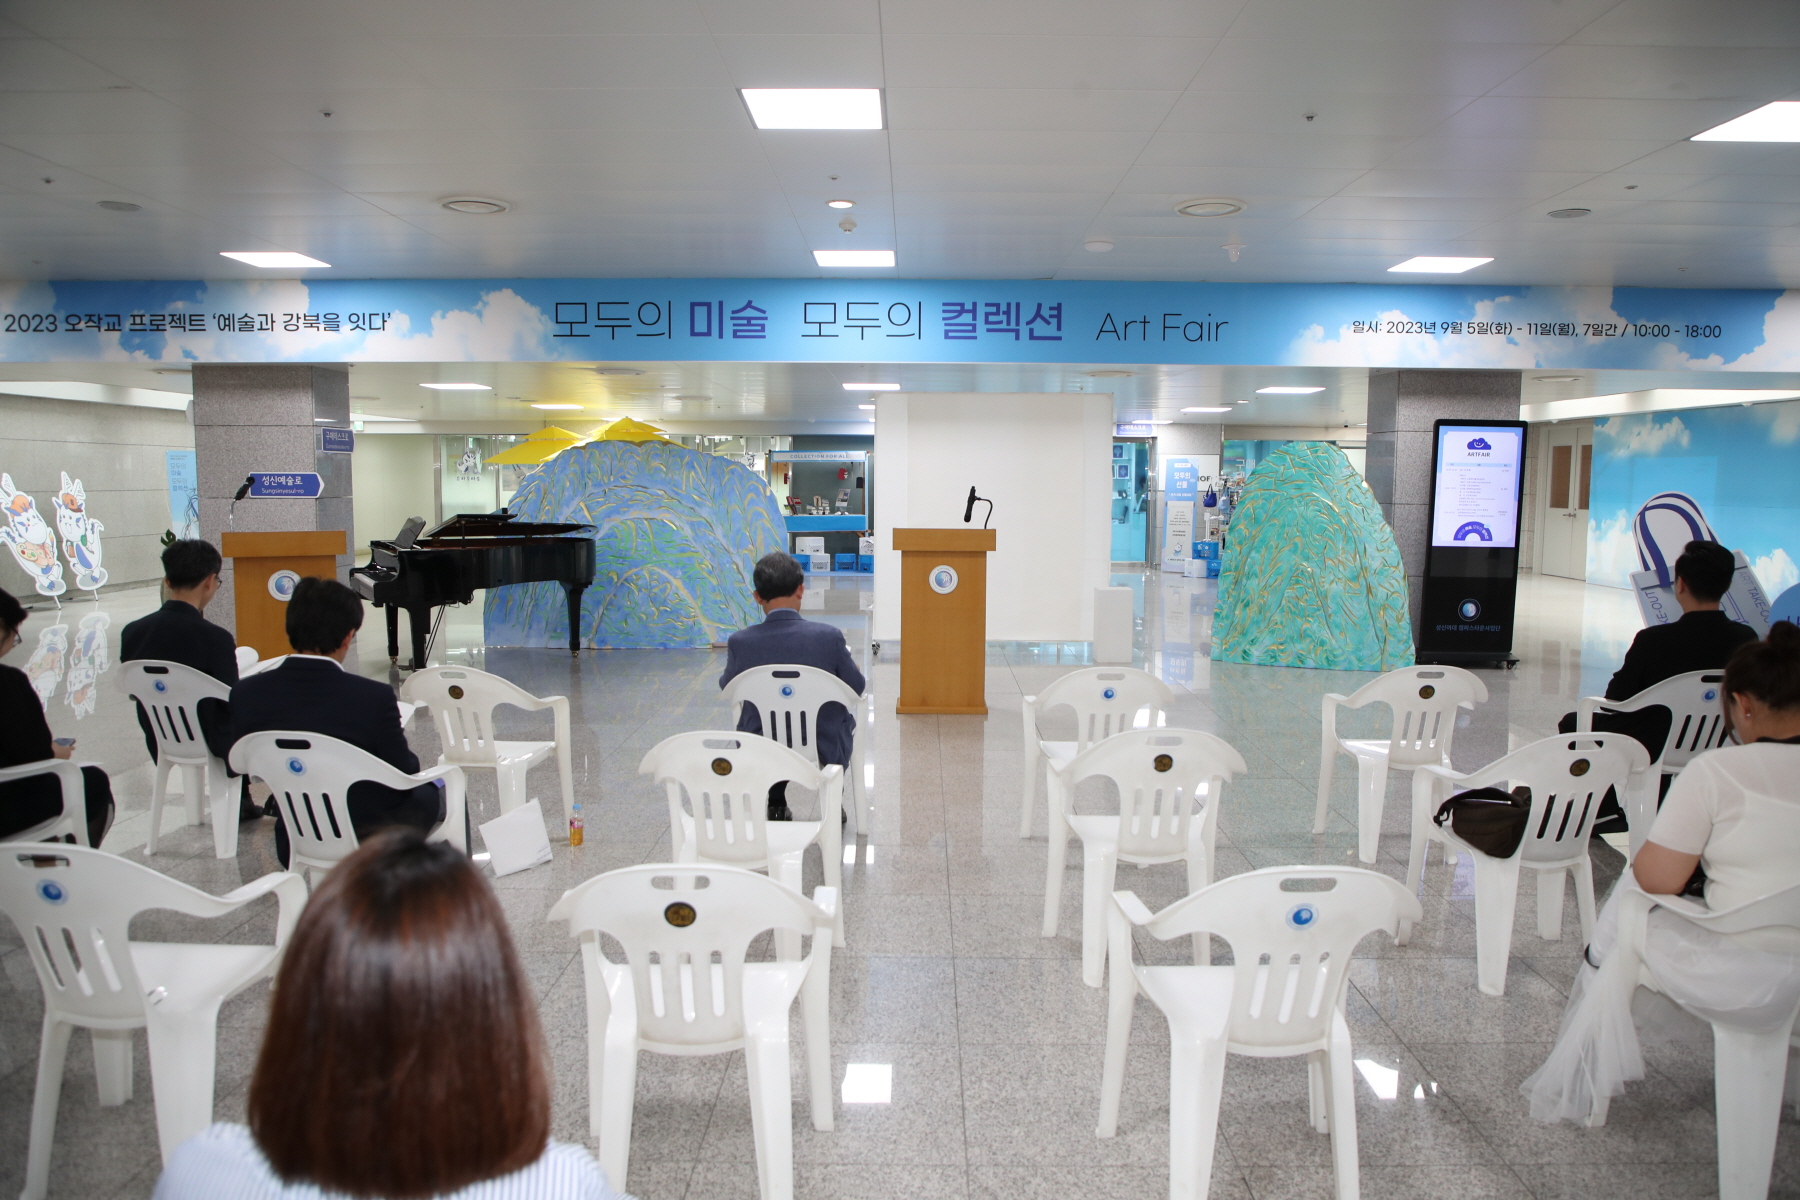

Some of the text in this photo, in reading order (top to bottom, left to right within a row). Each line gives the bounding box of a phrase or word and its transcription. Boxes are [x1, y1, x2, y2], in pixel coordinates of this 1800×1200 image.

[4, 314, 59, 333] 2023
[64, 313, 123, 332] 오작교
[129, 313, 207, 333] 프로젝트
[282, 312, 341, 333] 강북을
[553, 299, 1229, 342] 모두의 미술 모두의 컬렉션 Art Fair
[1352, 320, 1382, 334] 일시:
[1387, 320, 1437, 335] 2023년
[1440, 321, 1463, 335] 9월
[1467, 322, 1513, 337] 5일(화)
[1527, 322, 1579, 338] 11일(월),
[1583, 323, 1618, 337] 7일간
[1621, 324, 1628, 338] /
[1632, 324, 1671, 338] 10:00
[1684, 325, 1722, 339] 18:00
[261, 475, 303, 486] 성신예술로
[1173, 472, 1191, 480] 모두의
[1737, 571, 1754, 588] ART
